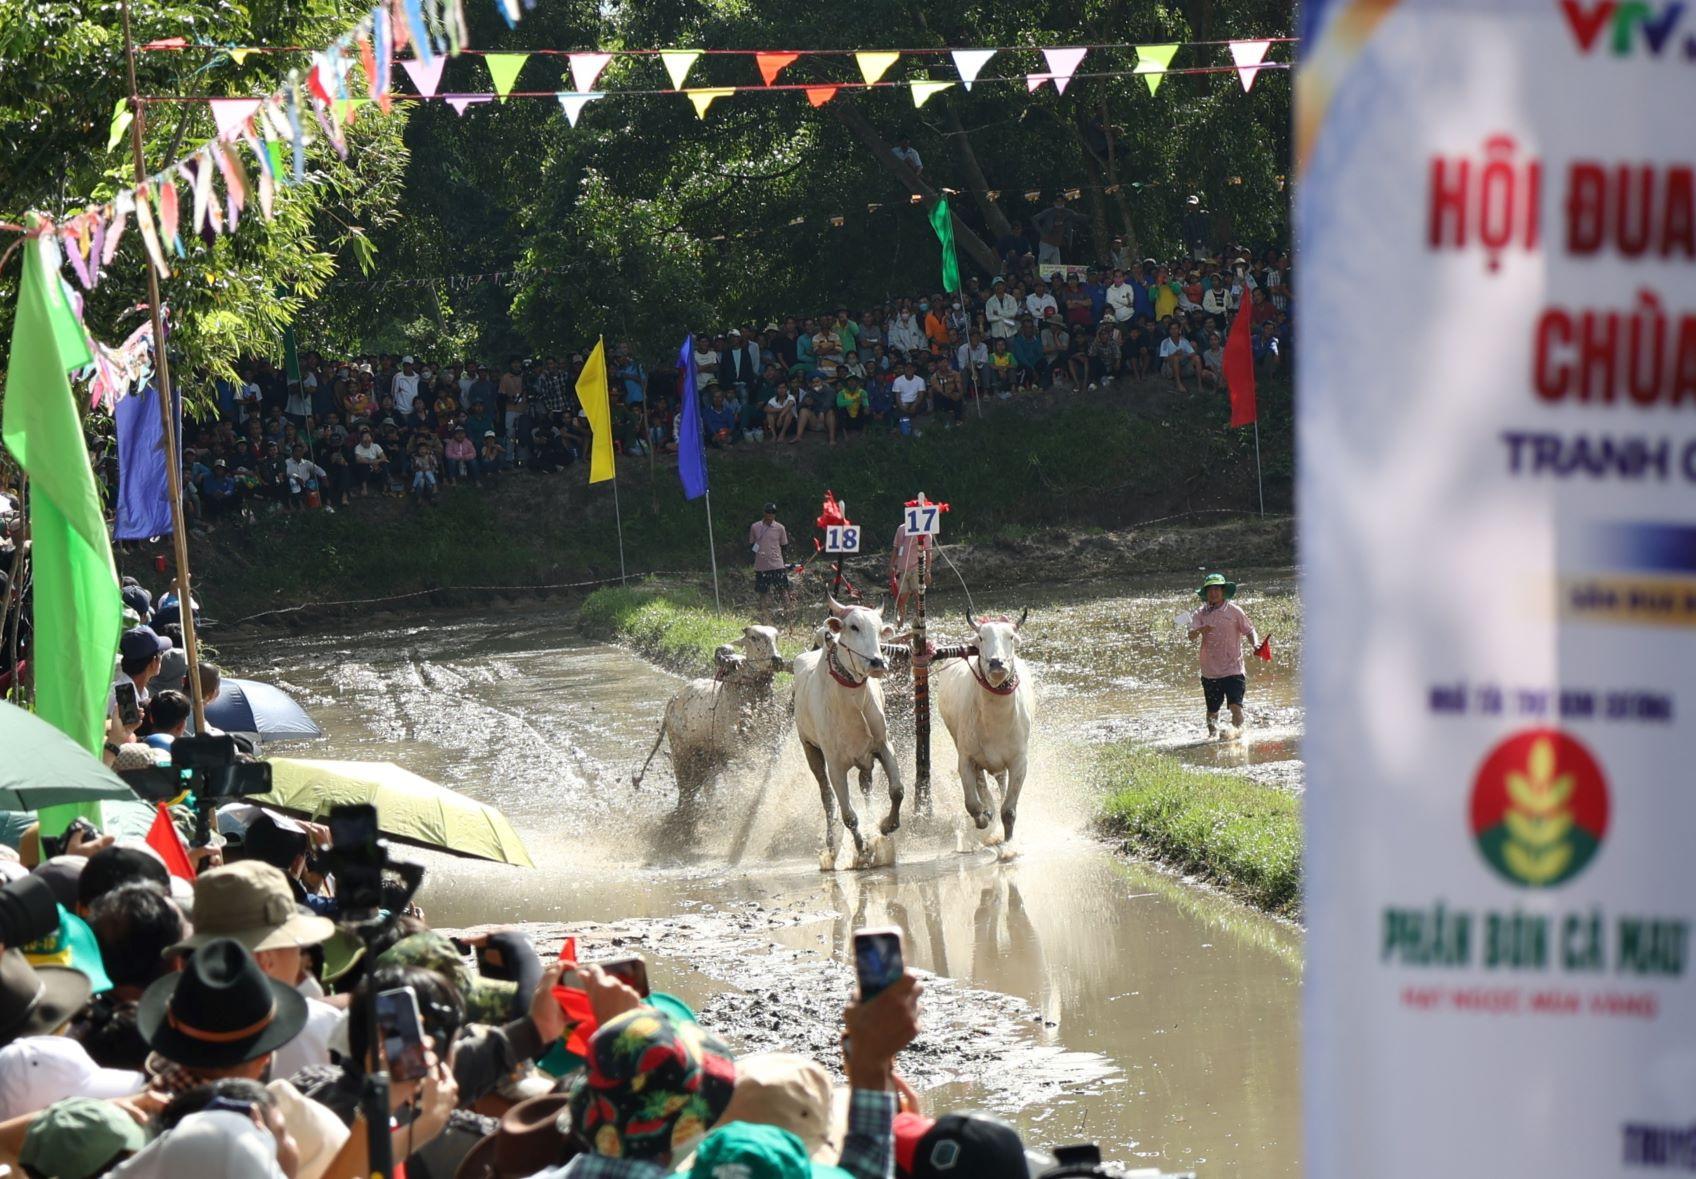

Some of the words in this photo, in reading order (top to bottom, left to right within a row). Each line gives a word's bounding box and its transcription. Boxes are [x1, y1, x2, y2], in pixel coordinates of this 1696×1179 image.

[1557, 0, 1696, 61] VTV
[1428, 134, 1542, 275] HỘI
[1564, 160, 1696, 261] ĐUA
[1501, 432, 1670, 482] TRANH
[828, 528, 857, 550] 18
[907, 508, 937, 533] 17
[1622, 1116, 1696, 1173] TRUY
